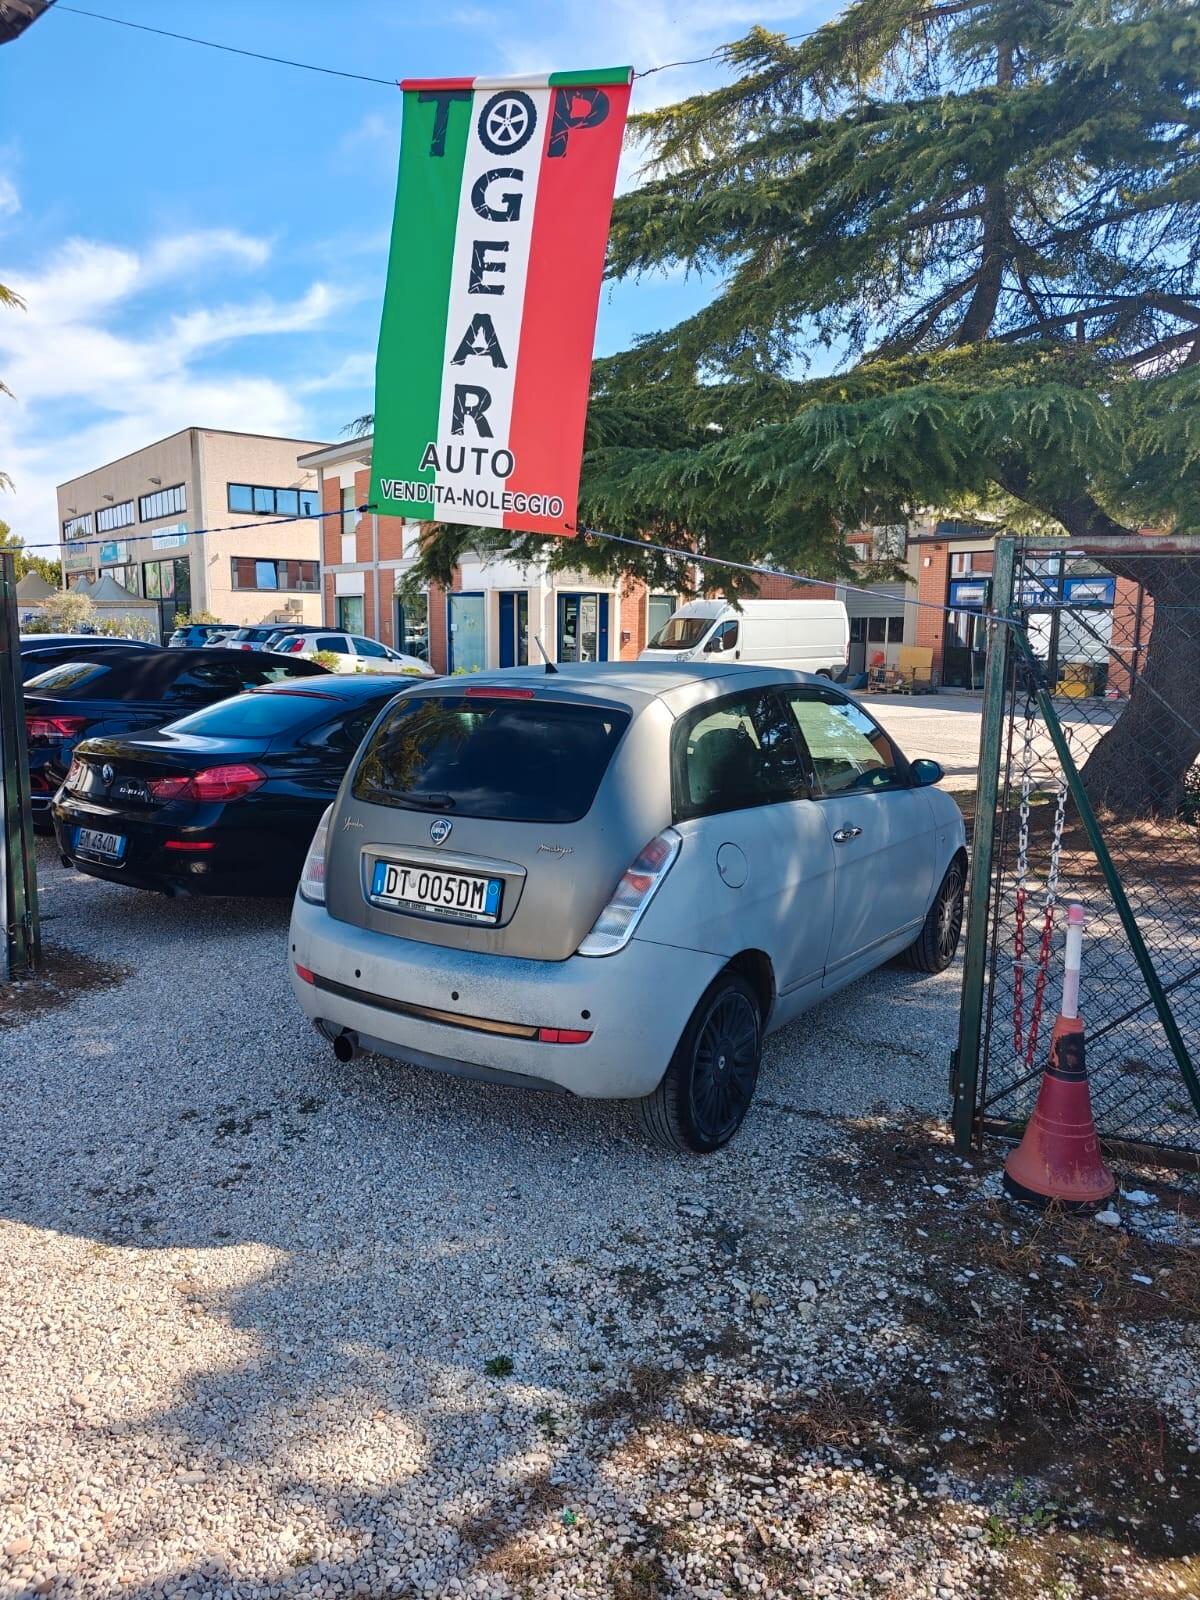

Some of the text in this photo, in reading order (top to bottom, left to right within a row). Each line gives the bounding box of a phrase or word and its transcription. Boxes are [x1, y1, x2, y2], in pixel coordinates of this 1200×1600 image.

[449, 167, 525, 439] GEAR
[419, 443, 515, 479] AUTO
[381, 479, 564, 517] VENDITA-NOLEGGIO
[386, 867, 411, 896] DT
[417, 873, 485, 909] 005DM
